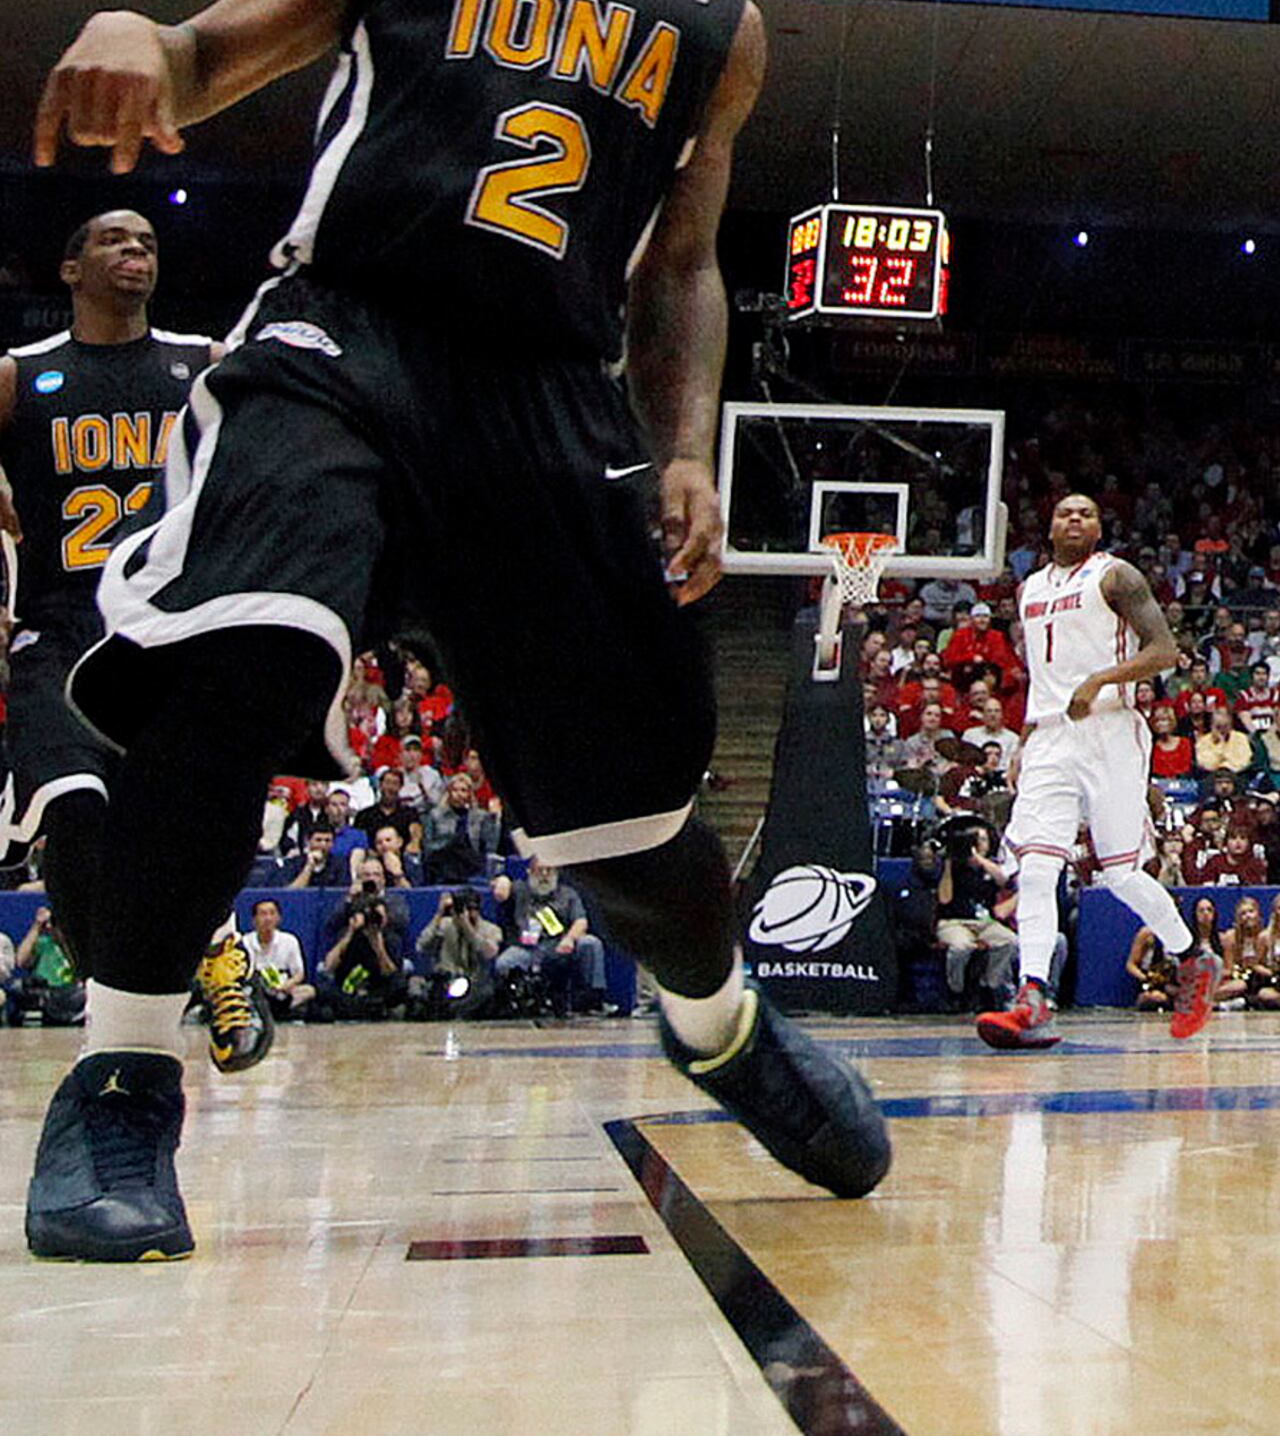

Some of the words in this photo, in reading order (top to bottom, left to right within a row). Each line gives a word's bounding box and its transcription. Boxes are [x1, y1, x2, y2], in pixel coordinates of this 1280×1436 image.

[462, 99, 593, 261] 2
[843, 215, 933, 252] 18:03
[843, 254, 914, 306] 32
[1044, 621, 1054, 664] 1
[757, 961, 880, 982] BASKETBALL
